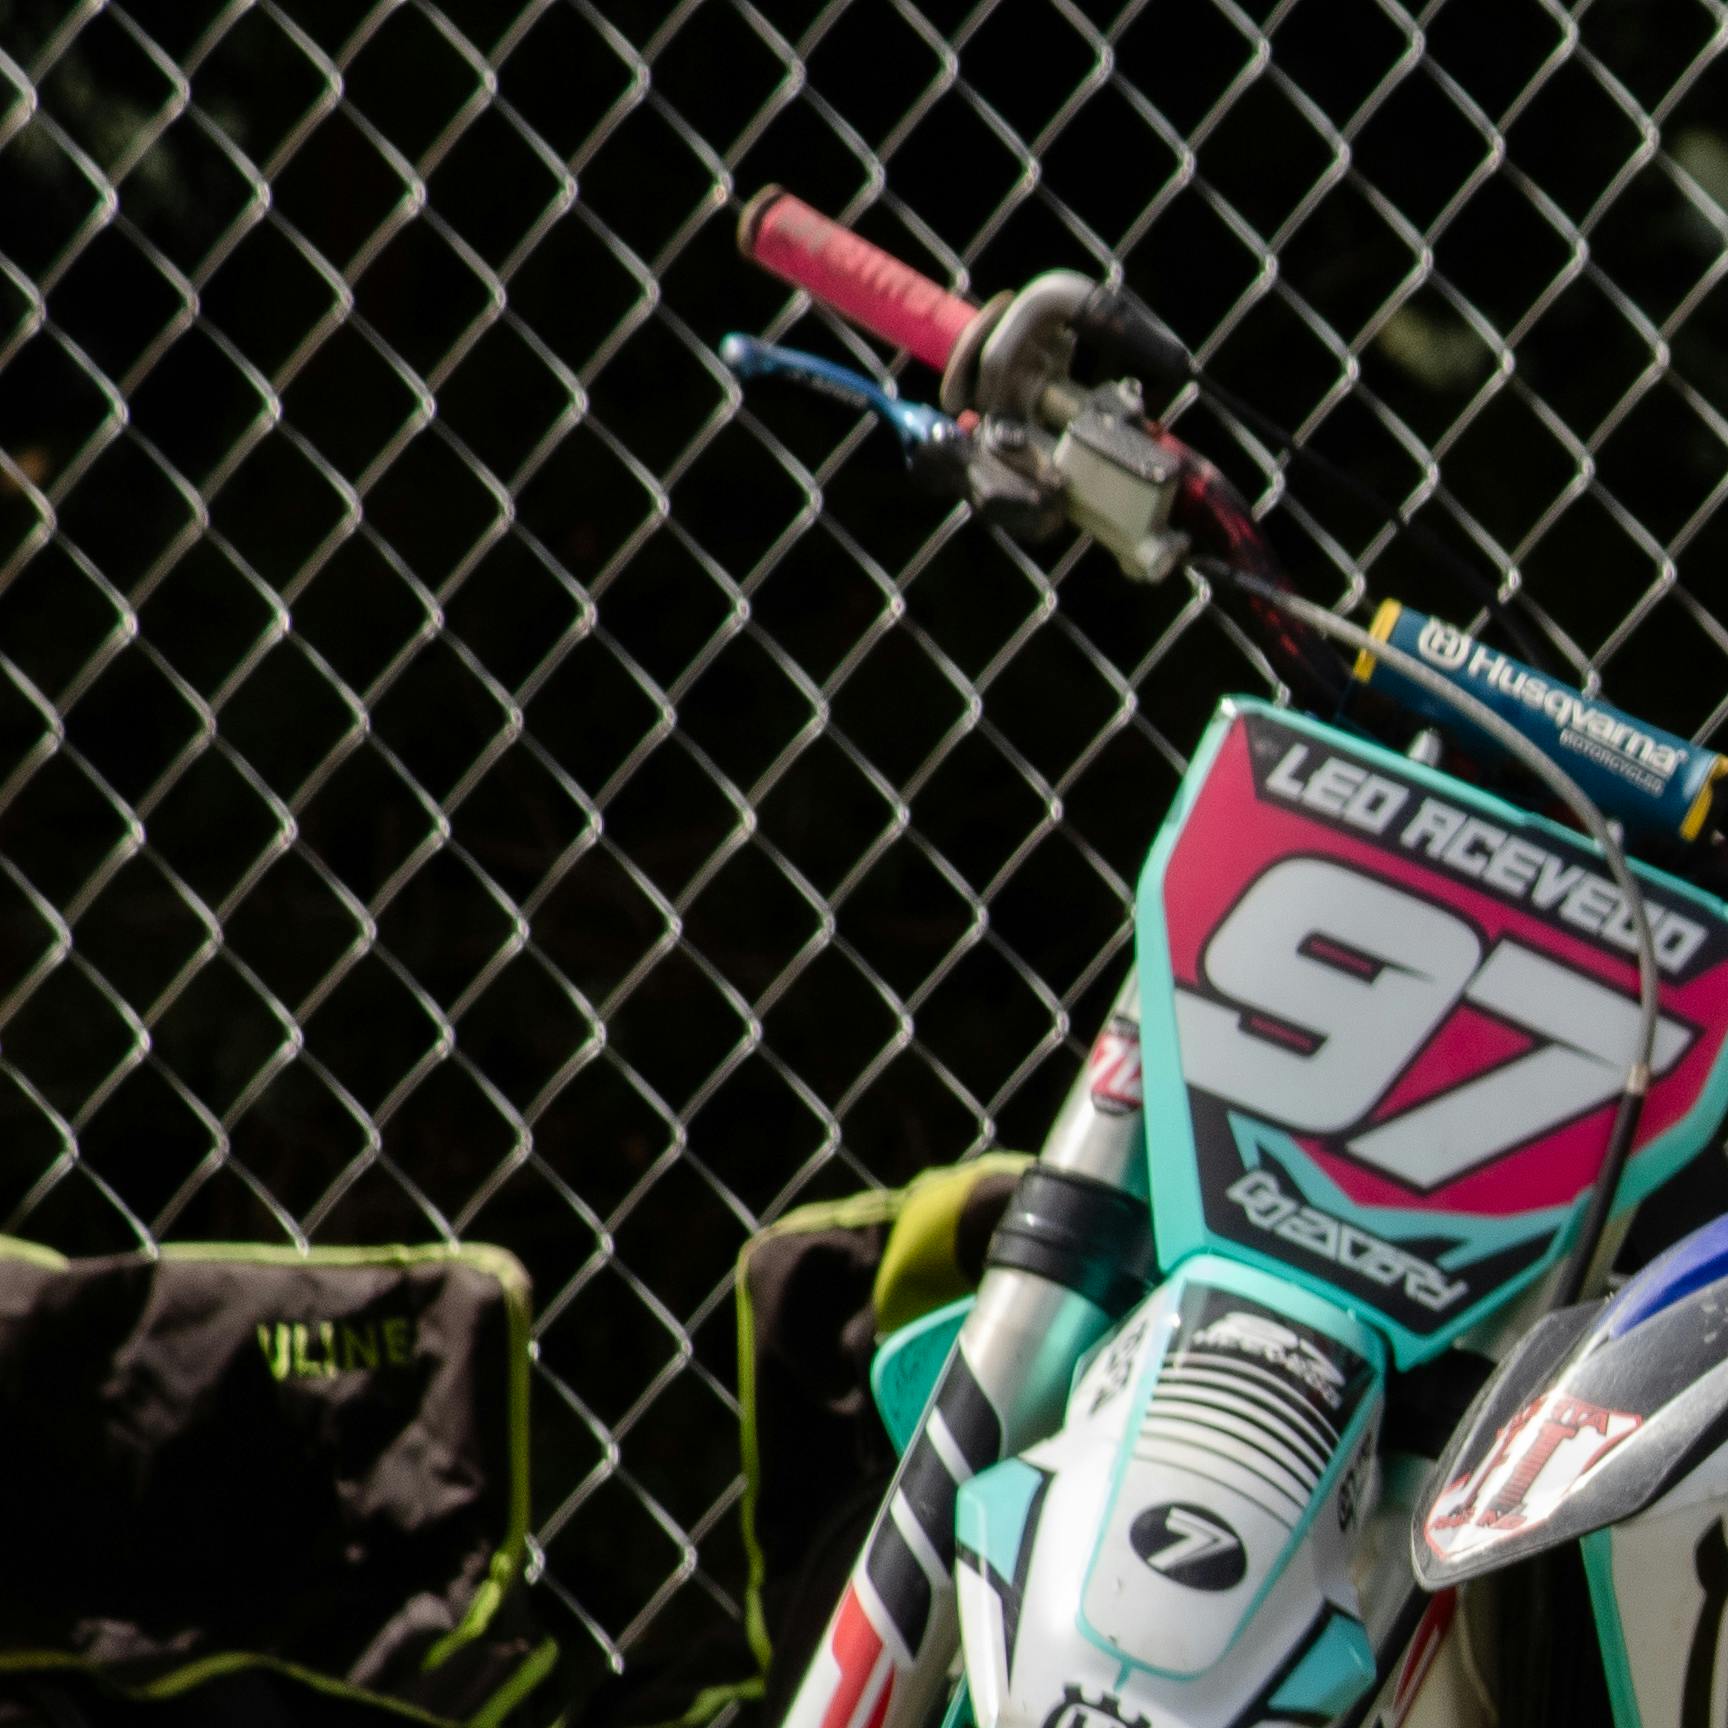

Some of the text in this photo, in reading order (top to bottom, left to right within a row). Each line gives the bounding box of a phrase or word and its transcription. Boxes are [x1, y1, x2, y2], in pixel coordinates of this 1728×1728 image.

[1468, 645, 1684, 780] Husqvarna
[1266, 743, 1707, 974] LEO ACEVEDO
[1175, 857, 1699, 1189] 97
